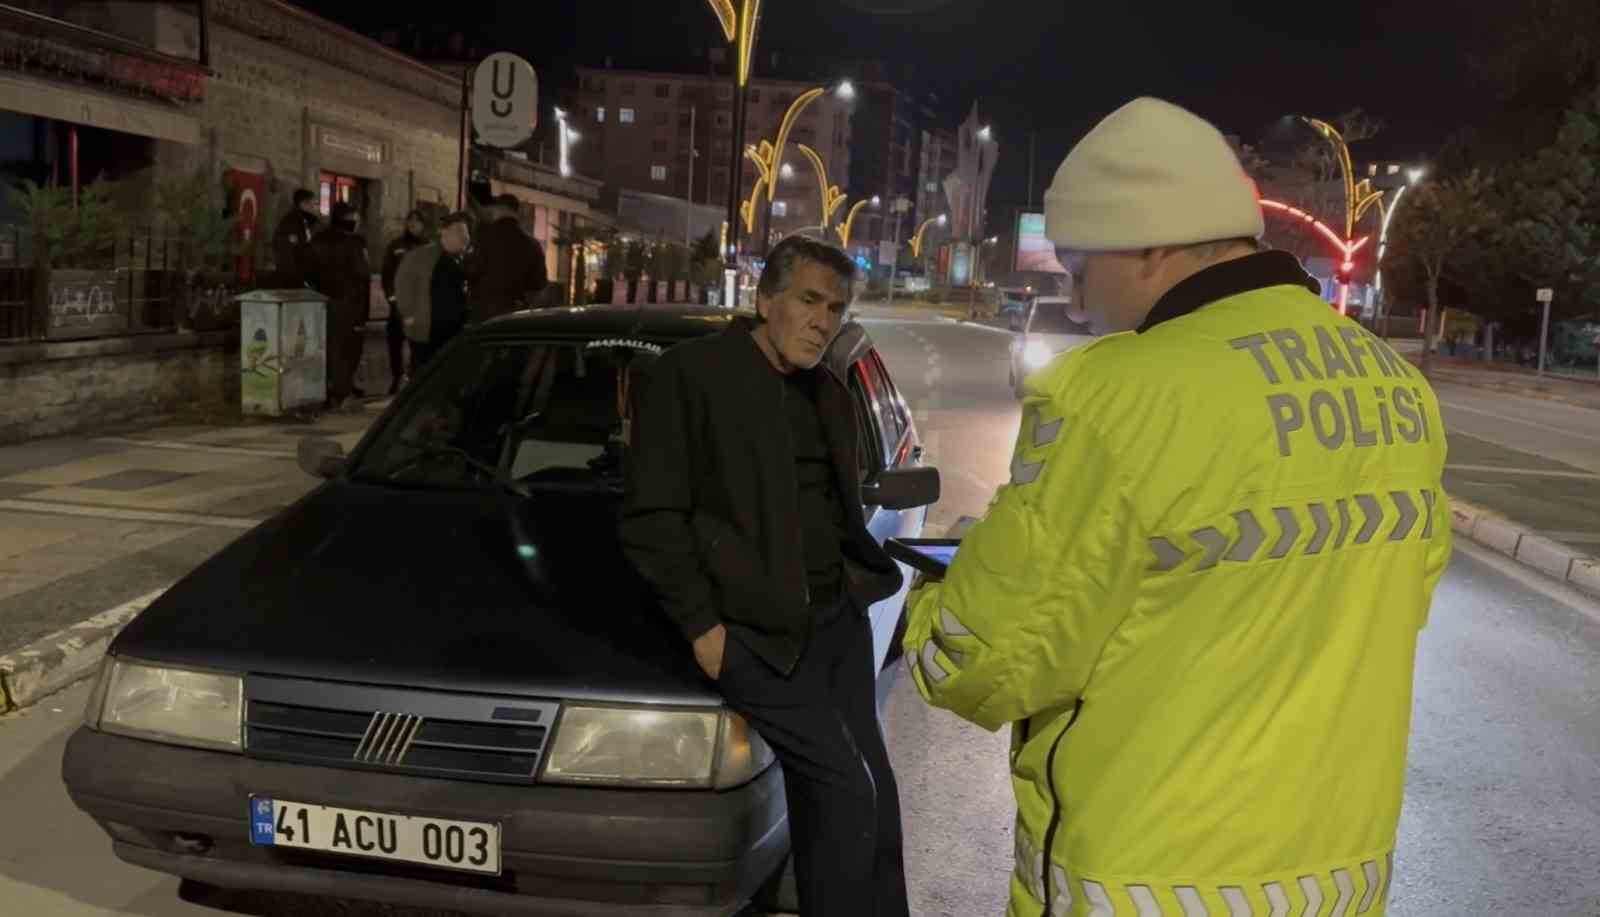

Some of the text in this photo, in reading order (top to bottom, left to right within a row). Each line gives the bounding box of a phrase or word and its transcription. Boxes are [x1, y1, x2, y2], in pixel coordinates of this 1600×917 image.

[1229, 325, 1412, 385] TRAFİK
[1265, 385, 1430, 456] POLİSİ
[256, 822, 273, 833] TR
[276, 806, 488, 866] 41 ACU 003
